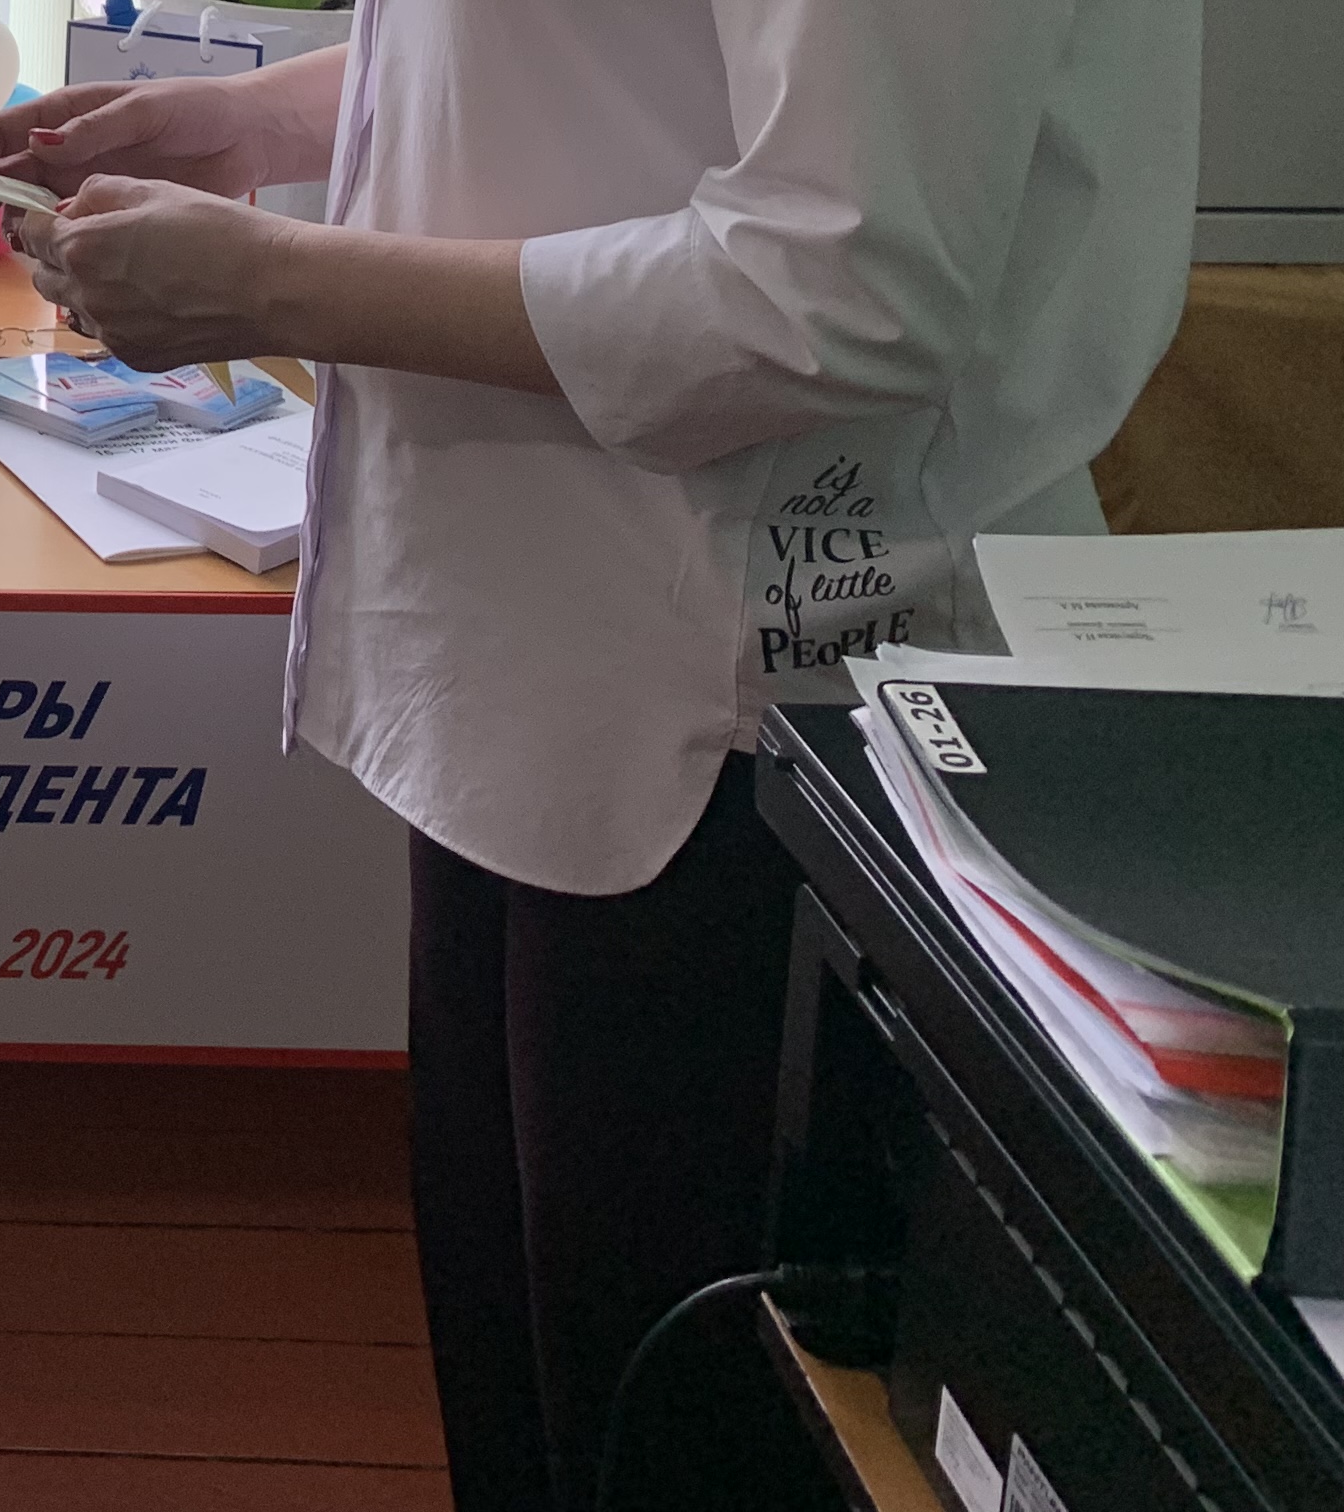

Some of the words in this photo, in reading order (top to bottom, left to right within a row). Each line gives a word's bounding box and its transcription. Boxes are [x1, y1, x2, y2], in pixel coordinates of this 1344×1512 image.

[780, 491, 842, 517] not
[847, 495, 875, 518] a
[768, 525, 890, 564] VICE
[765, 555, 802, 638] of
[811, 565, 896, 602] little
[899, 691, 974, 768] 01-26
